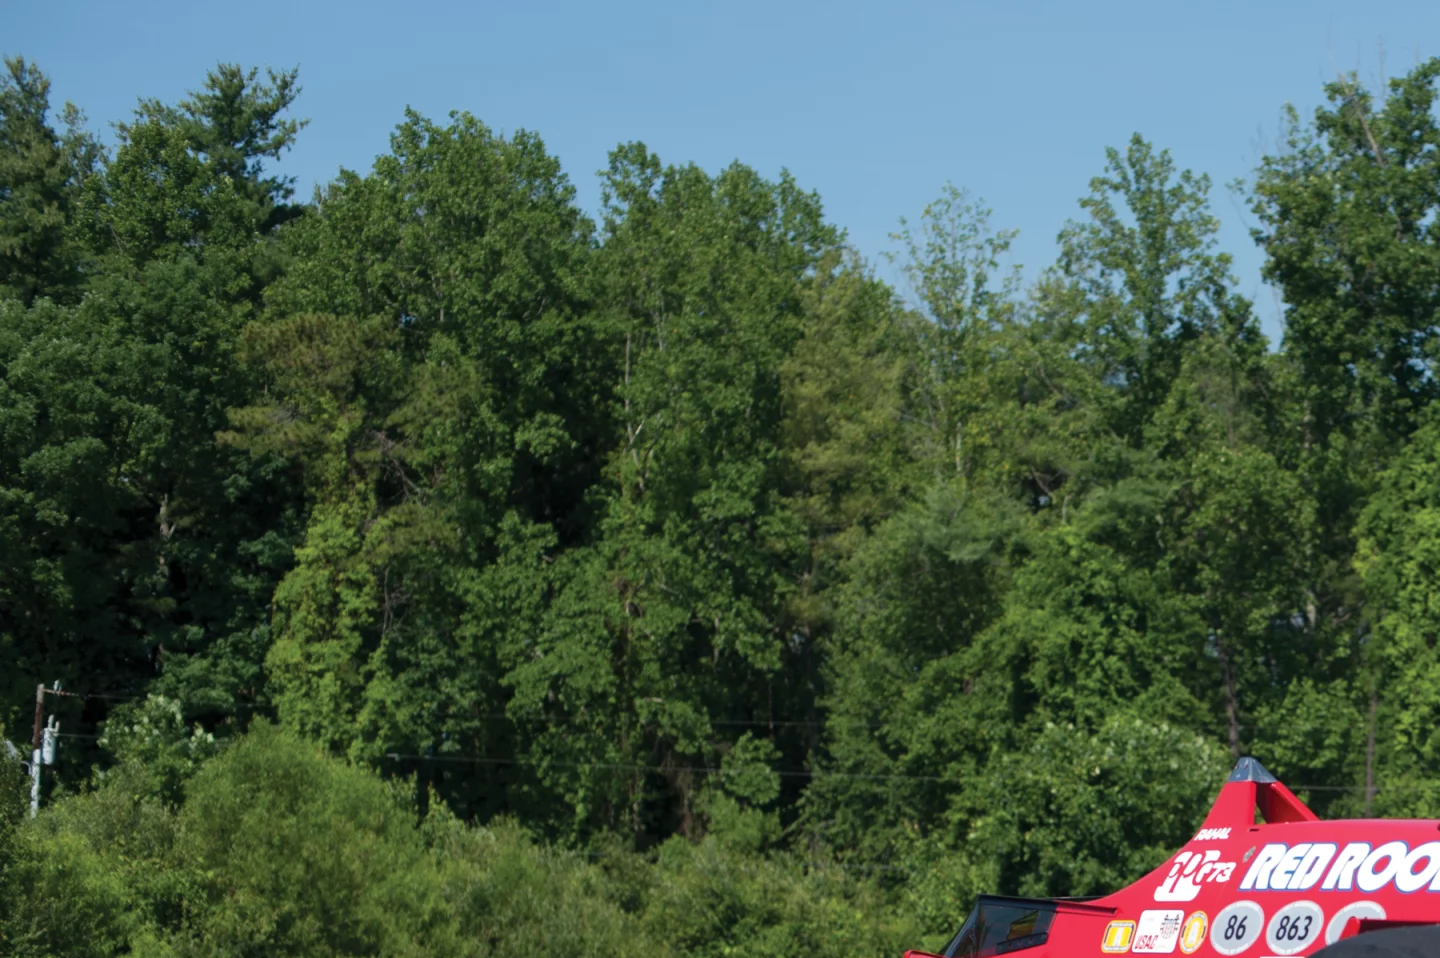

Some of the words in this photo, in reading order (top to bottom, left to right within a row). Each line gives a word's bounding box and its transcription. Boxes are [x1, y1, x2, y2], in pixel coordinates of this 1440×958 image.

[1238, 841, 1338, 892] RED
[1224, 914, 1248, 941] 86
[1275, 915, 1313, 941] 863
[1134, 935, 1159, 950] USAC
